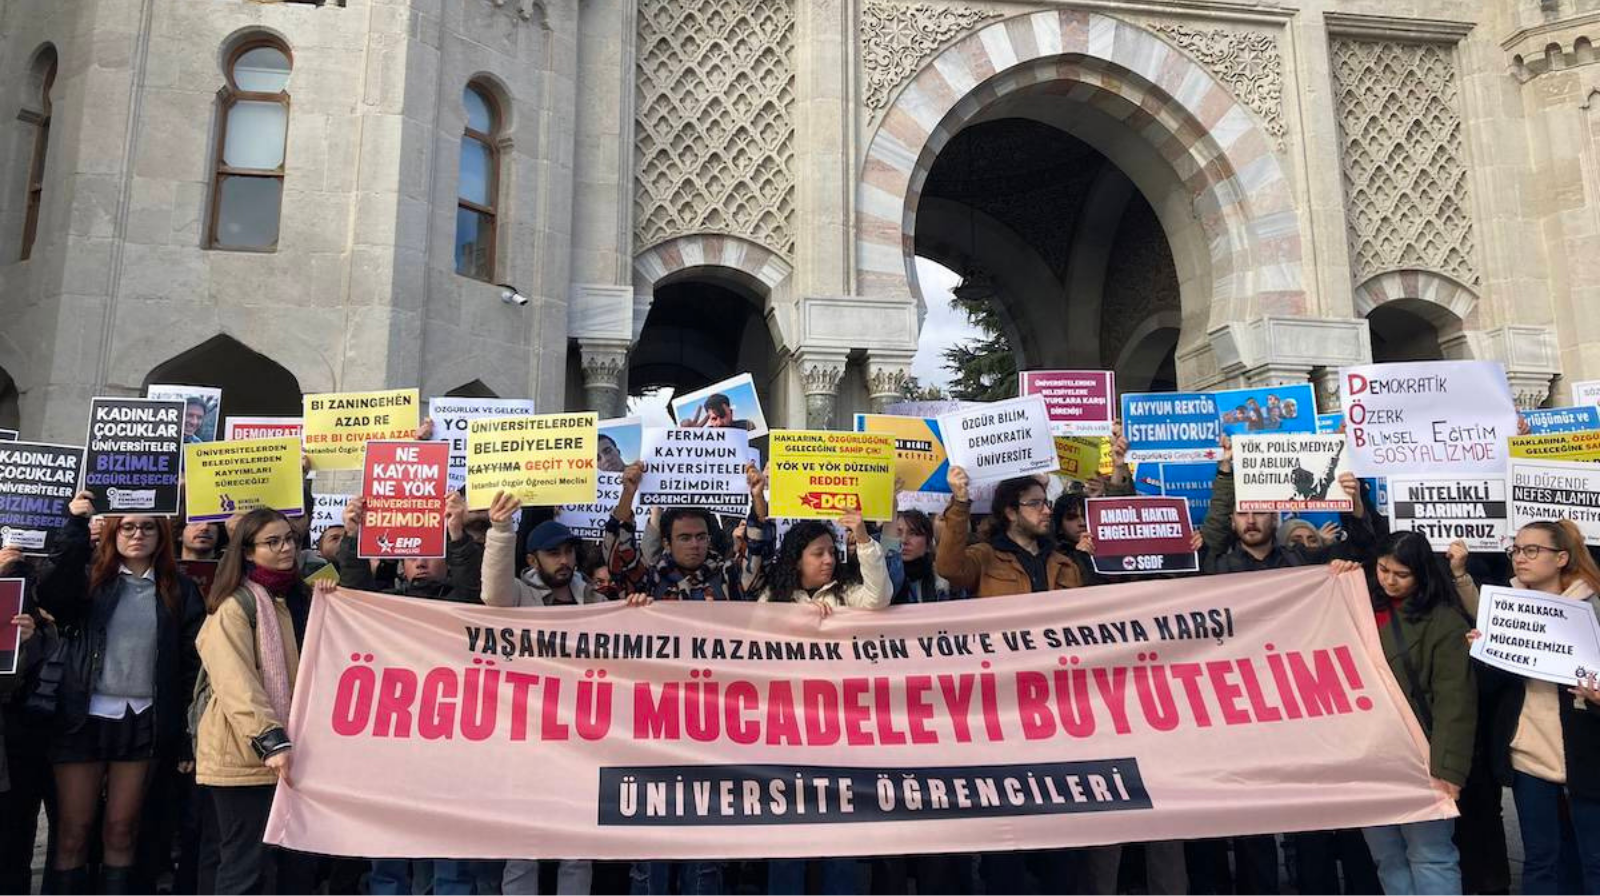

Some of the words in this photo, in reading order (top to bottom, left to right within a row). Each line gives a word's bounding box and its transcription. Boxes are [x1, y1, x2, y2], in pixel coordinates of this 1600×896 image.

[1348, 373, 1448, 396] DEMOKRATİK
[311, 401, 324, 411] BI
[495, 406, 530, 414] GELECEK
[1129, 400, 1173, 415] KAYYUM
[1175, 395, 1216, 414] REKTÖR
[1349, 400, 1405, 426] ÖZERK
[97, 406, 178, 422] KADINLAR
[335, 416, 370, 427] AZAD
[375, 415, 390, 425] RE
[962, 414, 996, 431] ÖZGÜR
[998, 409, 1029, 429] BİLİM,
[1576, 412, 1590, 423] ve
[443, 416, 468, 431] YÖ
[471, 417, 594, 434] ÜNİVERSİTELERDEN
[1127, 419, 1220, 442] İSTEMİYORUZ!
[93, 423, 178, 441] ÇOCUKLAR
[306, 434, 328, 444] BER
[667, 430, 726, 441] FERMAN
[774, 434, 826, 443] HAKLARINA,
[969, 427, 1033, 449] DEMOKRATİK
[1354, 427, 1419, 448] BİLİMSEL
[1432, 420, 1497, 444] EĞİTİM
[91, 438, 178, 453] ÜNİVERSİTELER
[474, 437, 584, 455] BELEDİYELERE
[785, 445, 837, 453] GELECEĞİNE
[839, 445, 864, 454] SAHİP
[1240, 439, 1264, 453] YÖK,
[1512, 437, 1570, 447] HAKLARINA,
[1525, 445, 1584, 455] GELECEĞİNE
[195, 444, 288, 458] ÜNİVERSİTELERDEN
[395, 447, 420, 462] NE
[655, 447, 738, 458] KAYYUMUN
[976, 447, 1033, 467] ÜNİVERSİTE
[1372, 443, 1497, 465] SOSYALİZMDE
[0, 450, 77, 469] KADINLAR
[96, 452, 169, 472] BİZİMLE
[202, 455, 282, 468] BELEDİYELERDEN
[468, 461, 521, 476] KAYYIMA
[525, 458, 561, 474] GEÇİT
[567, 458, 594, 470] YOK
[777, 460, 799, 471] YÖK
[802, 462, 815, 471] VE
[820, 461, 841, 472] YÖK
[844, 461, 890, 473] DÜZENİNİ
[1242, 458, 1257, 468] BU
[1260, 457, 1301, 468] ABLUKA
[86, 471, 178, 487] ÖZGÜRLEŞECEK
[214, 466, 272, 477] KAYYIMLARI
[373, 463, 439, 480] KAYYIM
[372, 482, 396, 496] NE
[403, 478, 437, 496] YÖK
[558, 475, 588, 486] Meclisi
[660, 478, 730, 491] BİZİMDİR!
[810, 475, 859, 487] REDDET!
[1515, 473, 1530, 486] BU
[1534, 472, 1589, 491] DÜZENDE
[644, 493, 691, 504] ÖĞRENCİ
[694, 493, 746, 504] FAALİYETİ
[1407, 481, 1490, 501] NİTELİKLİ
[1514, 487, 1553, 503] NEFES
[366, 496, 441, 509] ÜNİVERSİTELER
[821, 493, 858, 508] DGB
[1100, 506, 1140, 524] ANADİL
[1141, 507, 1180, 522] HAKTIR
[1413, 502, 1487, 519] BARINMA
[1515, 504, 1566, 519] YAŞAMAK
[366, 511, 441, 528] BİZİMDİR
[1097, 524, 1183, 541] ENGELLENEMEZ!
[395, 537, 422, 548] EHP
[1137, 555, 1164, 570] SGDF
[1494, 599, 1515, 611] YÖK
[1517, 602, 1568, 620] KALKACAK,
[1491, 616, 1547, 634] ÖZGÜRLÜK
[465, 626, 681, 662] YAŞAMLARIMIZI
[692, 637, 843, 661] KAZANMAK
[852, 634, 910, 665] İÇİN
[917, 630, 996, 657] YÖK'E
[1002, 629, 1036, 652] VE
[1046, 619, 1150, 649] SARAYA
[1156, 607, 1236, 646] KARŞI
[1489, 633, 1574, 655] MÜCADELEMİZLE
[1485, 647, 1531, 666] GELECEK
[331, 652, 614, 742] ÖRGÜTLÜ
[632, 660, 1005, 747] MÜCADELEYİ
[1014, 643, 1374, 742] BÜYÜTELİM!
[619, 772, 855, 817] ÜNİVERSİTE
[875, 766, 1132, 812] ÖĞRENCİLERİ
